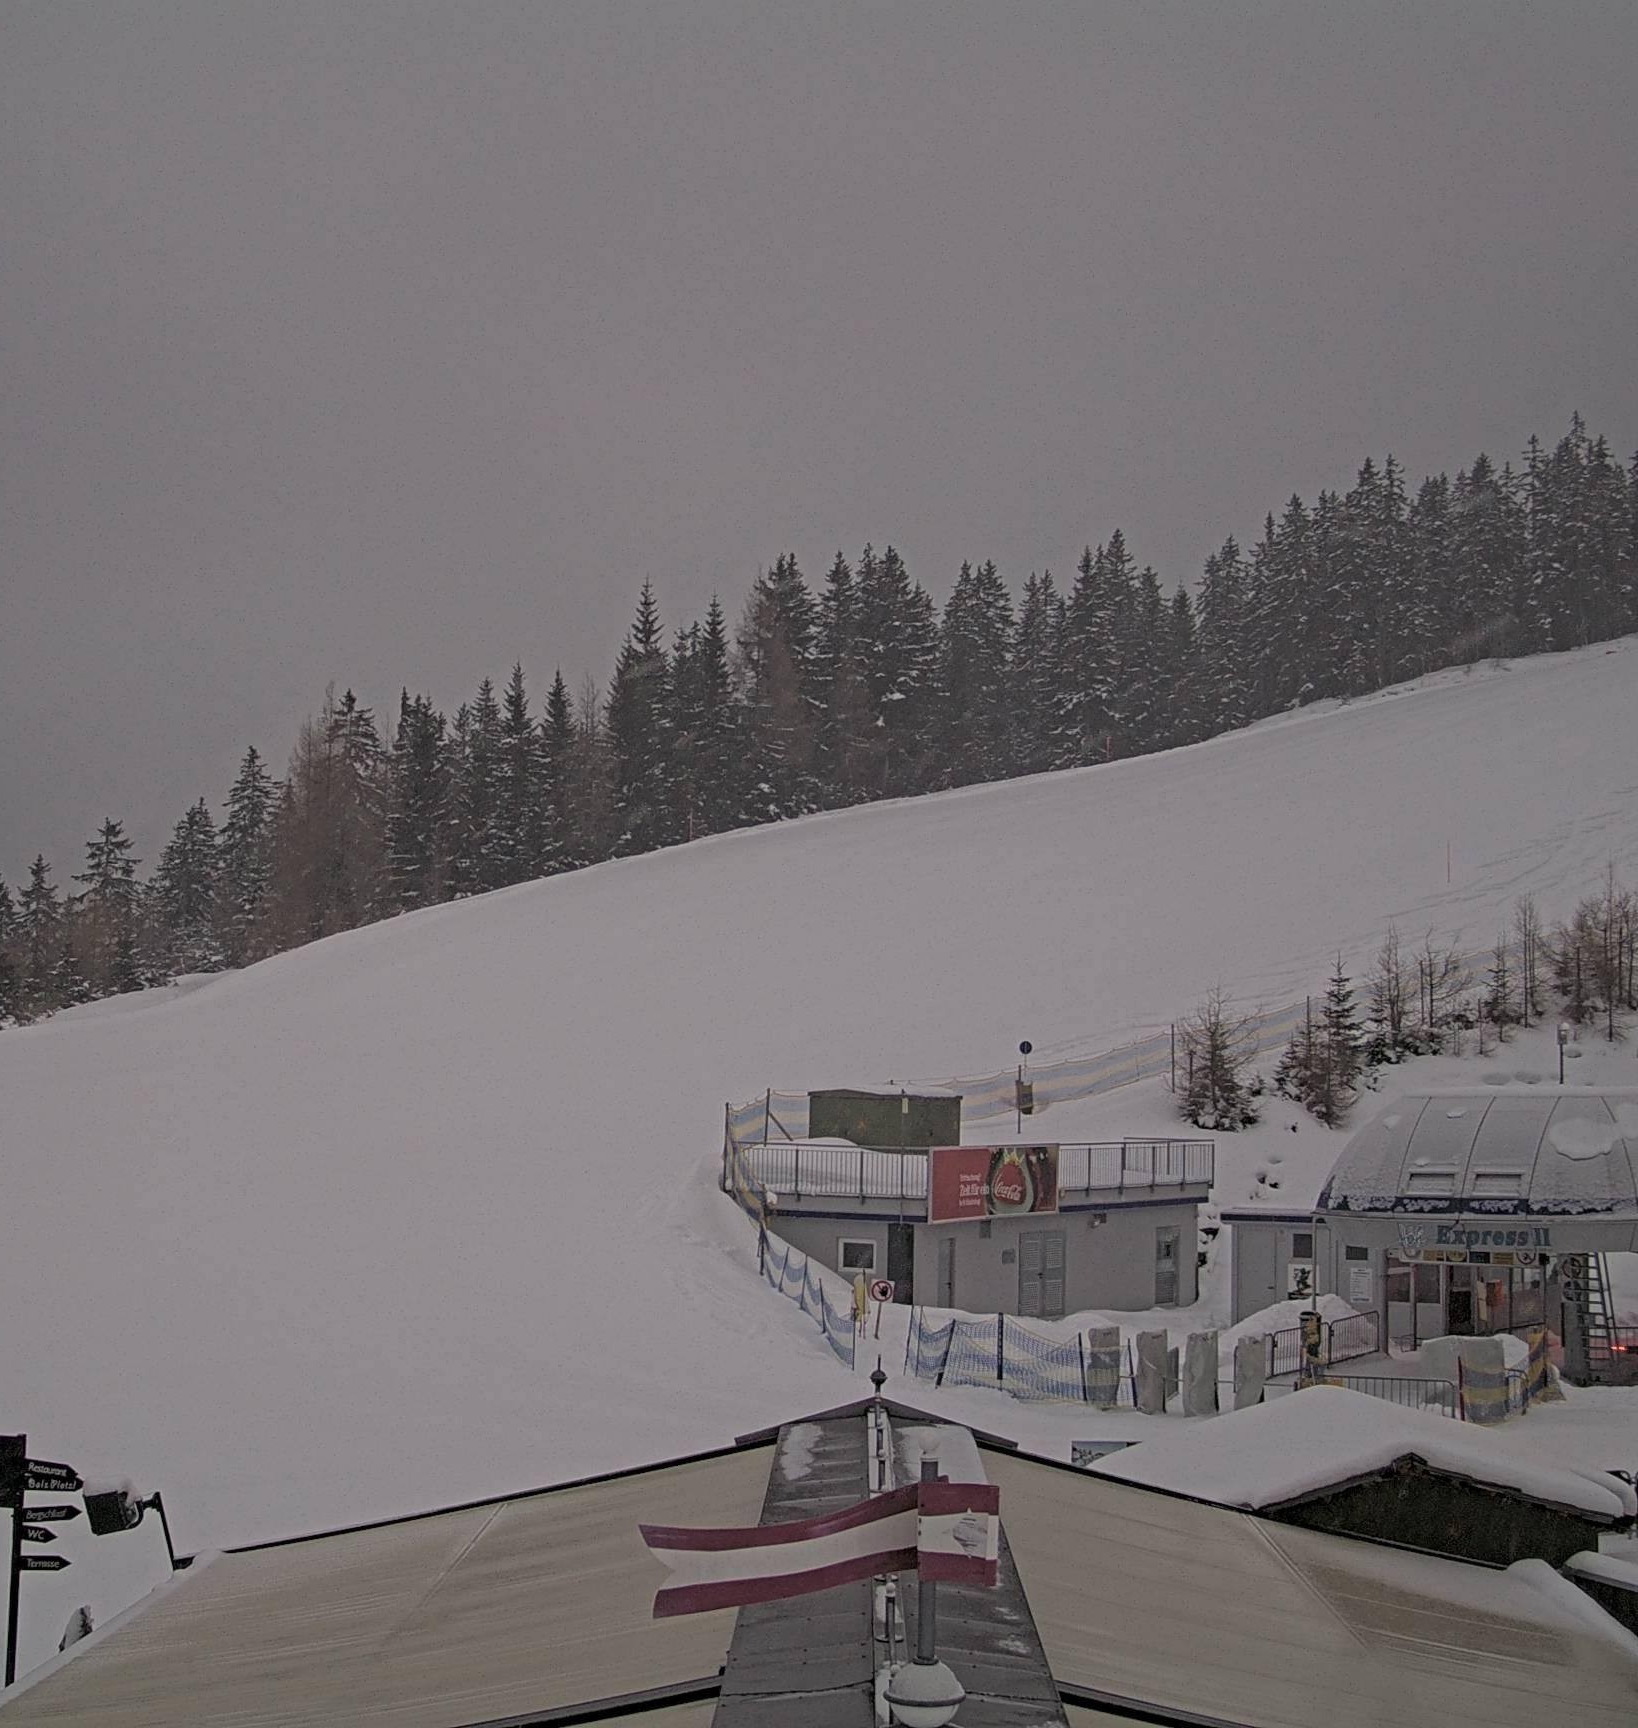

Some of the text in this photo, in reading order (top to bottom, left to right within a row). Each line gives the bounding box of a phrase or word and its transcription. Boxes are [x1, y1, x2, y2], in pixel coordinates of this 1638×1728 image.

[1436, 1225, 1530, 1249] Express
[27, 1529, 46, 1540] WC
[27, 1558, 60, 1569] Terrasse
